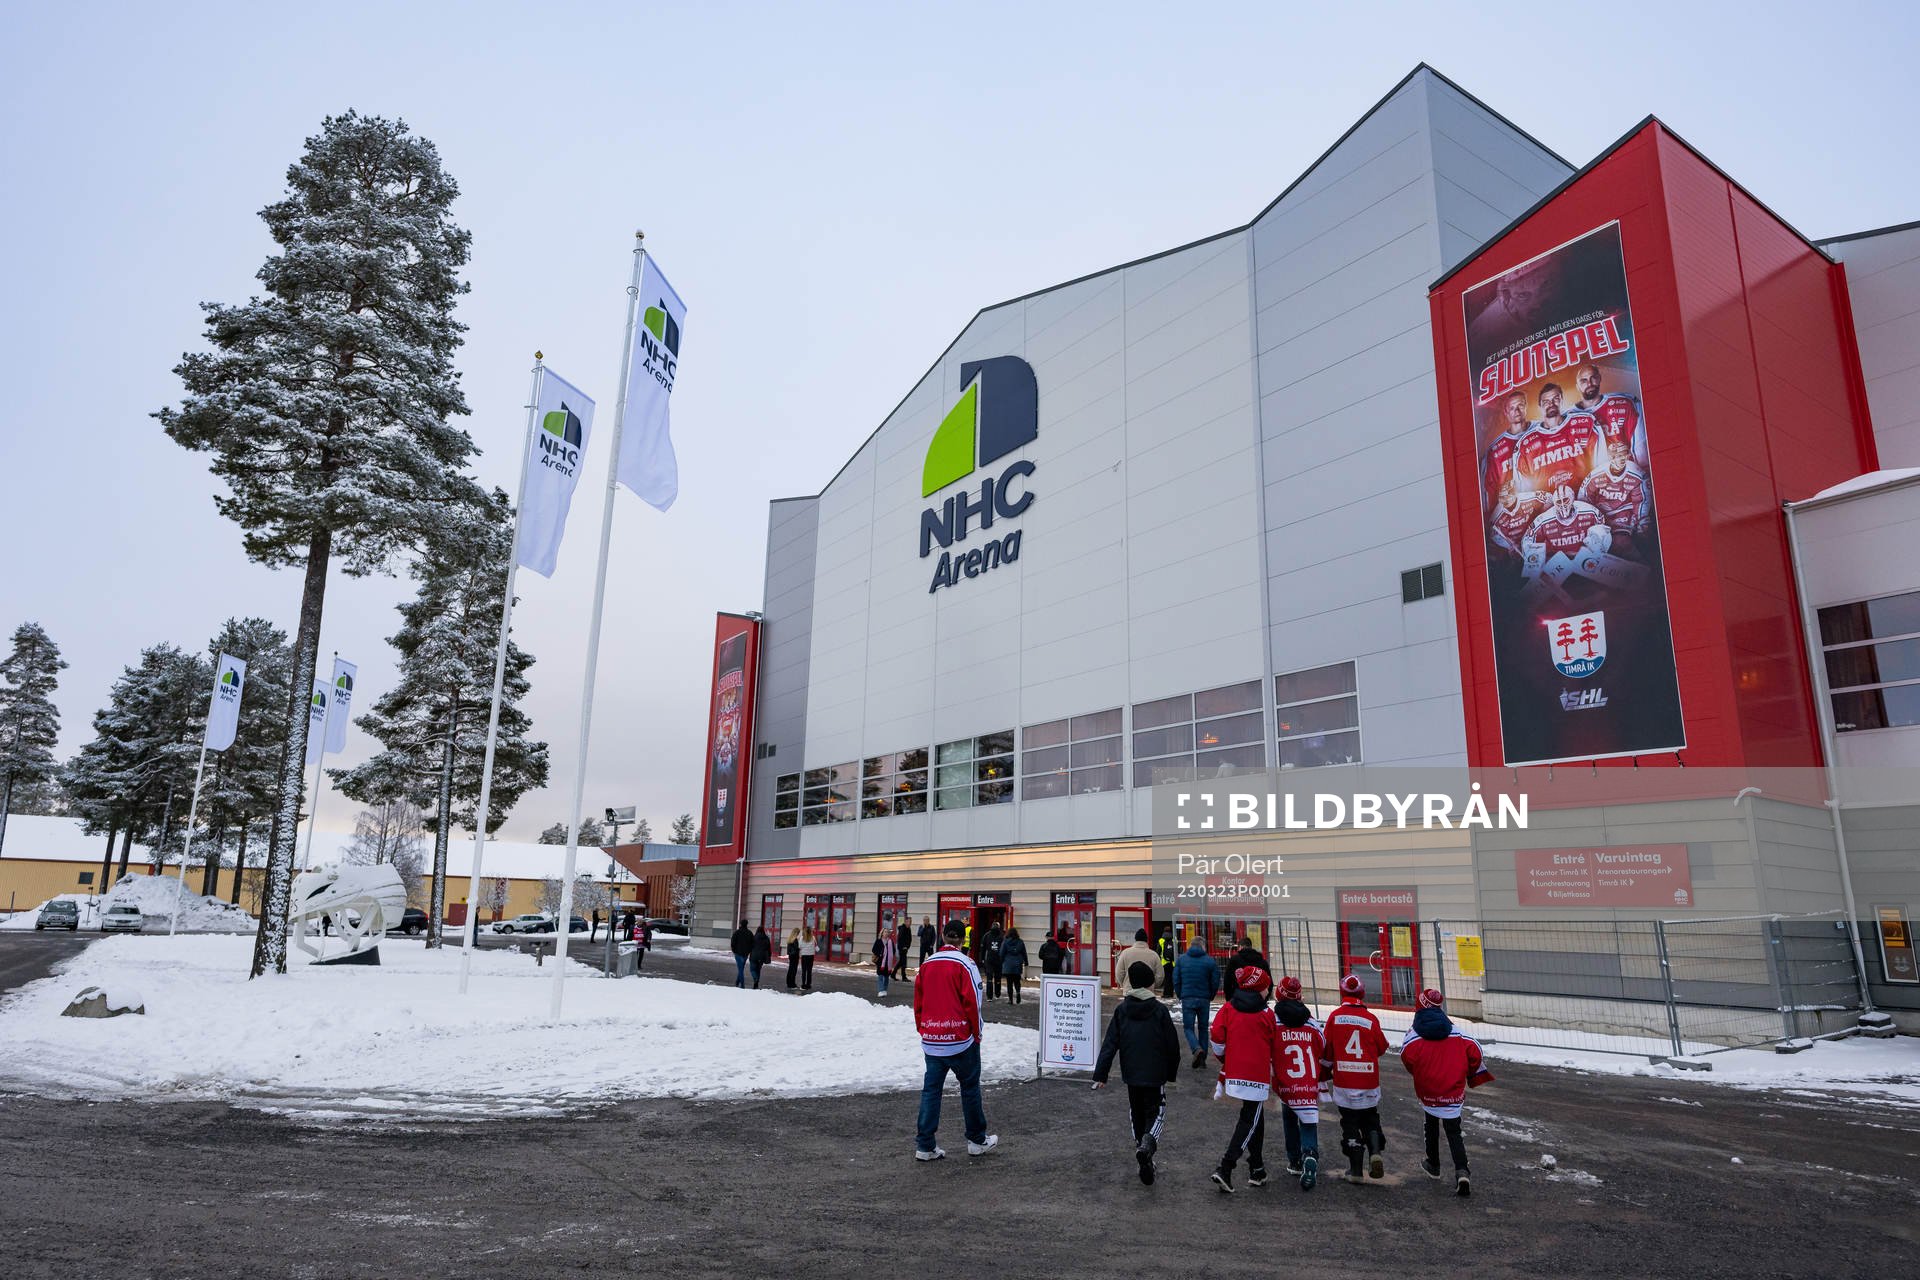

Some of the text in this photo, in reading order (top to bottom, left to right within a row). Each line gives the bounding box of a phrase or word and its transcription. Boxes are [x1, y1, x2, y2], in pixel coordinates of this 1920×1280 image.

[641, 330, 677, 381] NHC
[1479, 316, 1630, 405] SLUTSPEL
[539, 433, 579, 468] NHC
[1533, 439, 1584, 470] TIMRÅ
[920, 460, 1036, 558] NHC
[929, 529, 1022, 594] Arena
[1565, 660, 1595, 674] TIMRÅ IK
[219, 685, 238, 698] NHC
[1567, 688, 1608, 706] SHL
[1553, 852, 1662, 865] Entré Varuintag
[1536, 868, 1588, 877] Kontor Timrå IK
[1597, 867, 1667, 876] Arenarestaurangen
[1222, 876, 1246, 885] Kontor
[1536, 880, 1591, 888] Lunchrestaurang
[1599, 878, 1619, 887] Timrå
[1056, 894, 1076, 904] Entré
[1152, 893, 1176, 905] Entré
[1342, 892, 1413, 904] Entré bortastå
[1553, 891, 1591, 899] Biljettkassa
[1056, 988, 1078, 999] OBS
[1281, 1029, 1312, 1042] BÄCKMAN
[1345, 1029, 1363, 1059] 4
[1285, 1044, 1317, 1079] 31
[1229, 1080, 1265, 1089] BILBOLAGET
